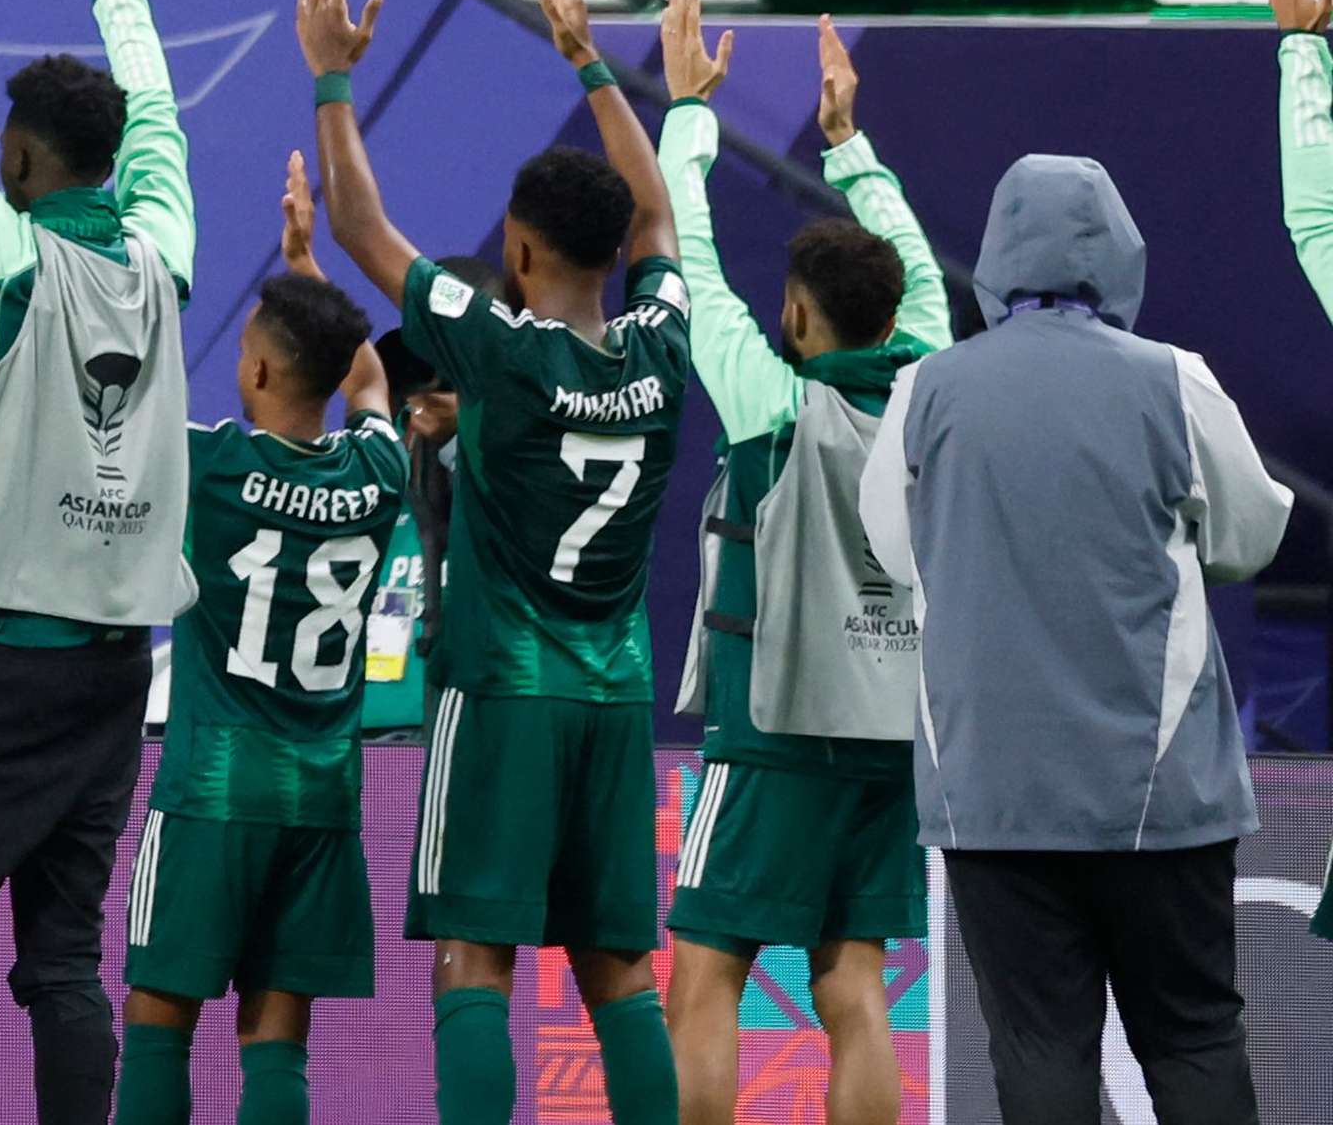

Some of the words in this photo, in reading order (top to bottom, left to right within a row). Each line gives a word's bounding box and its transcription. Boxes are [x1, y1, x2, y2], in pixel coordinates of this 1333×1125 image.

[59, 493, 122, 518] ASIAN
[125, 502, 152, 519] CUP
[100, 488, 125, 500] AFC
[242, 471, 380, 523] GHAREEB
[549, 431, 646, 583] 7
[62, 512, 115, 534] QATAR
[226, 528, 380, 692] 18
